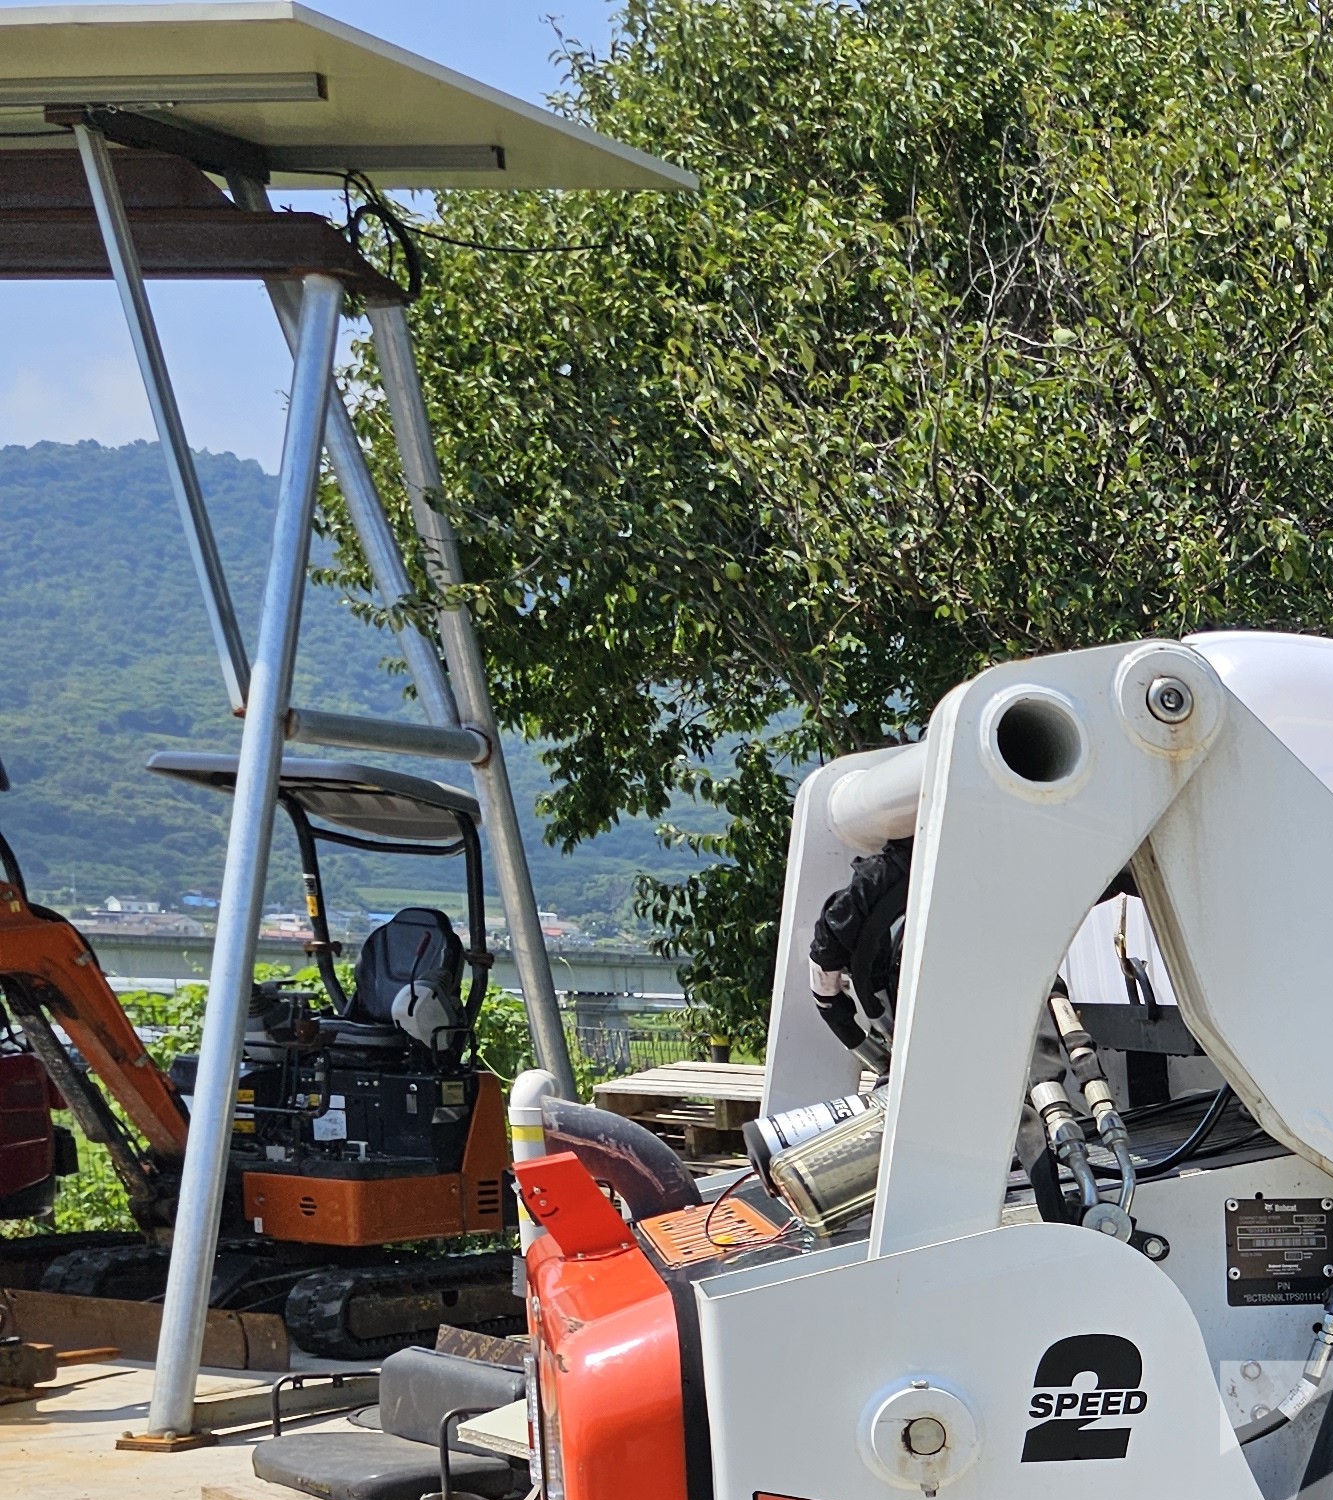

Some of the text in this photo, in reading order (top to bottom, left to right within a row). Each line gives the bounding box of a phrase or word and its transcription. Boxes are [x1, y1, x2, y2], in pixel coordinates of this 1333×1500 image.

[1277, 1282, 1291, 1290] PIN
[1021, 1333, 1143, 1463] 2
[1028, 1390, 1148, 1418] SPEED
